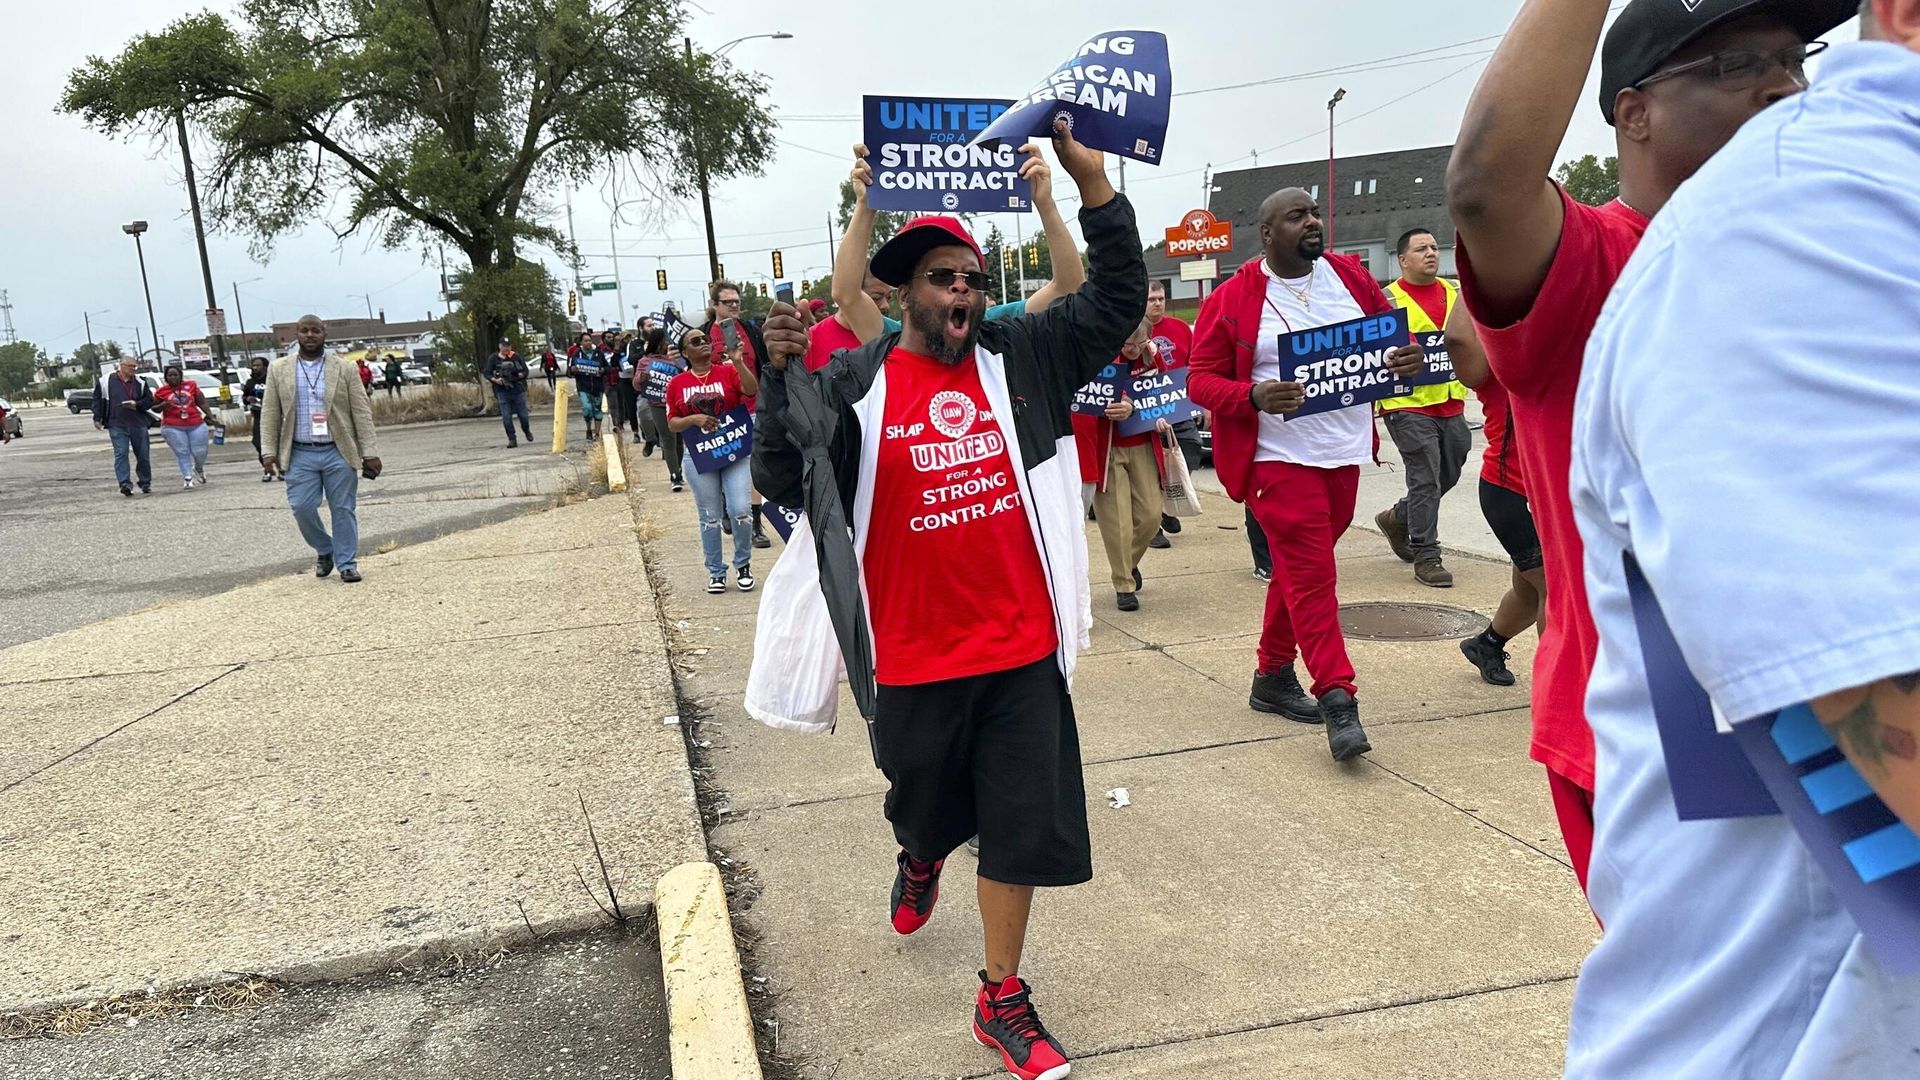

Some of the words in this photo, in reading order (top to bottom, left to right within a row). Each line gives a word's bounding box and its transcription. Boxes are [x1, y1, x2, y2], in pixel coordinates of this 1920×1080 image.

[929, 133, 955, 143] FOR
[957, 133, 967, 143] A
[880, 142, 1015, 168] STRONG
[879, 171, 1018, 190] CONTRACT
[1291, 315, 1397, 355] UNITED
[1331, 347, 1351, 357] FOR
[1354, 345, 1362, 353] A
[649, 370, 672, 381] STRO
[1133, 375, 1174, 392] COLA
[1305, 369, 1400, 398] ONTRAC
[682, 381, 725, 403] UNION
[1133, 396, 1158, 410] AIR
[1160, 387, 1187, 405] PAY
[943, 406, 962, 418] UAW
[1140, 403, 1176, 421] NOW
[696, 435, 726, 453] FAIR
[726, 423, 748, 442] PAY
[886, 423, 925, 439] SHAP
[711, 438, 742, 459] NOW
[910, 430, 1004, 472] UNITED
[946, 469, 969, 481] FOR
[972, 467, 982, 476] A
[922, 472, 1007, 505] STRONG
[910, 491, 1021, 532] CONTRACT
